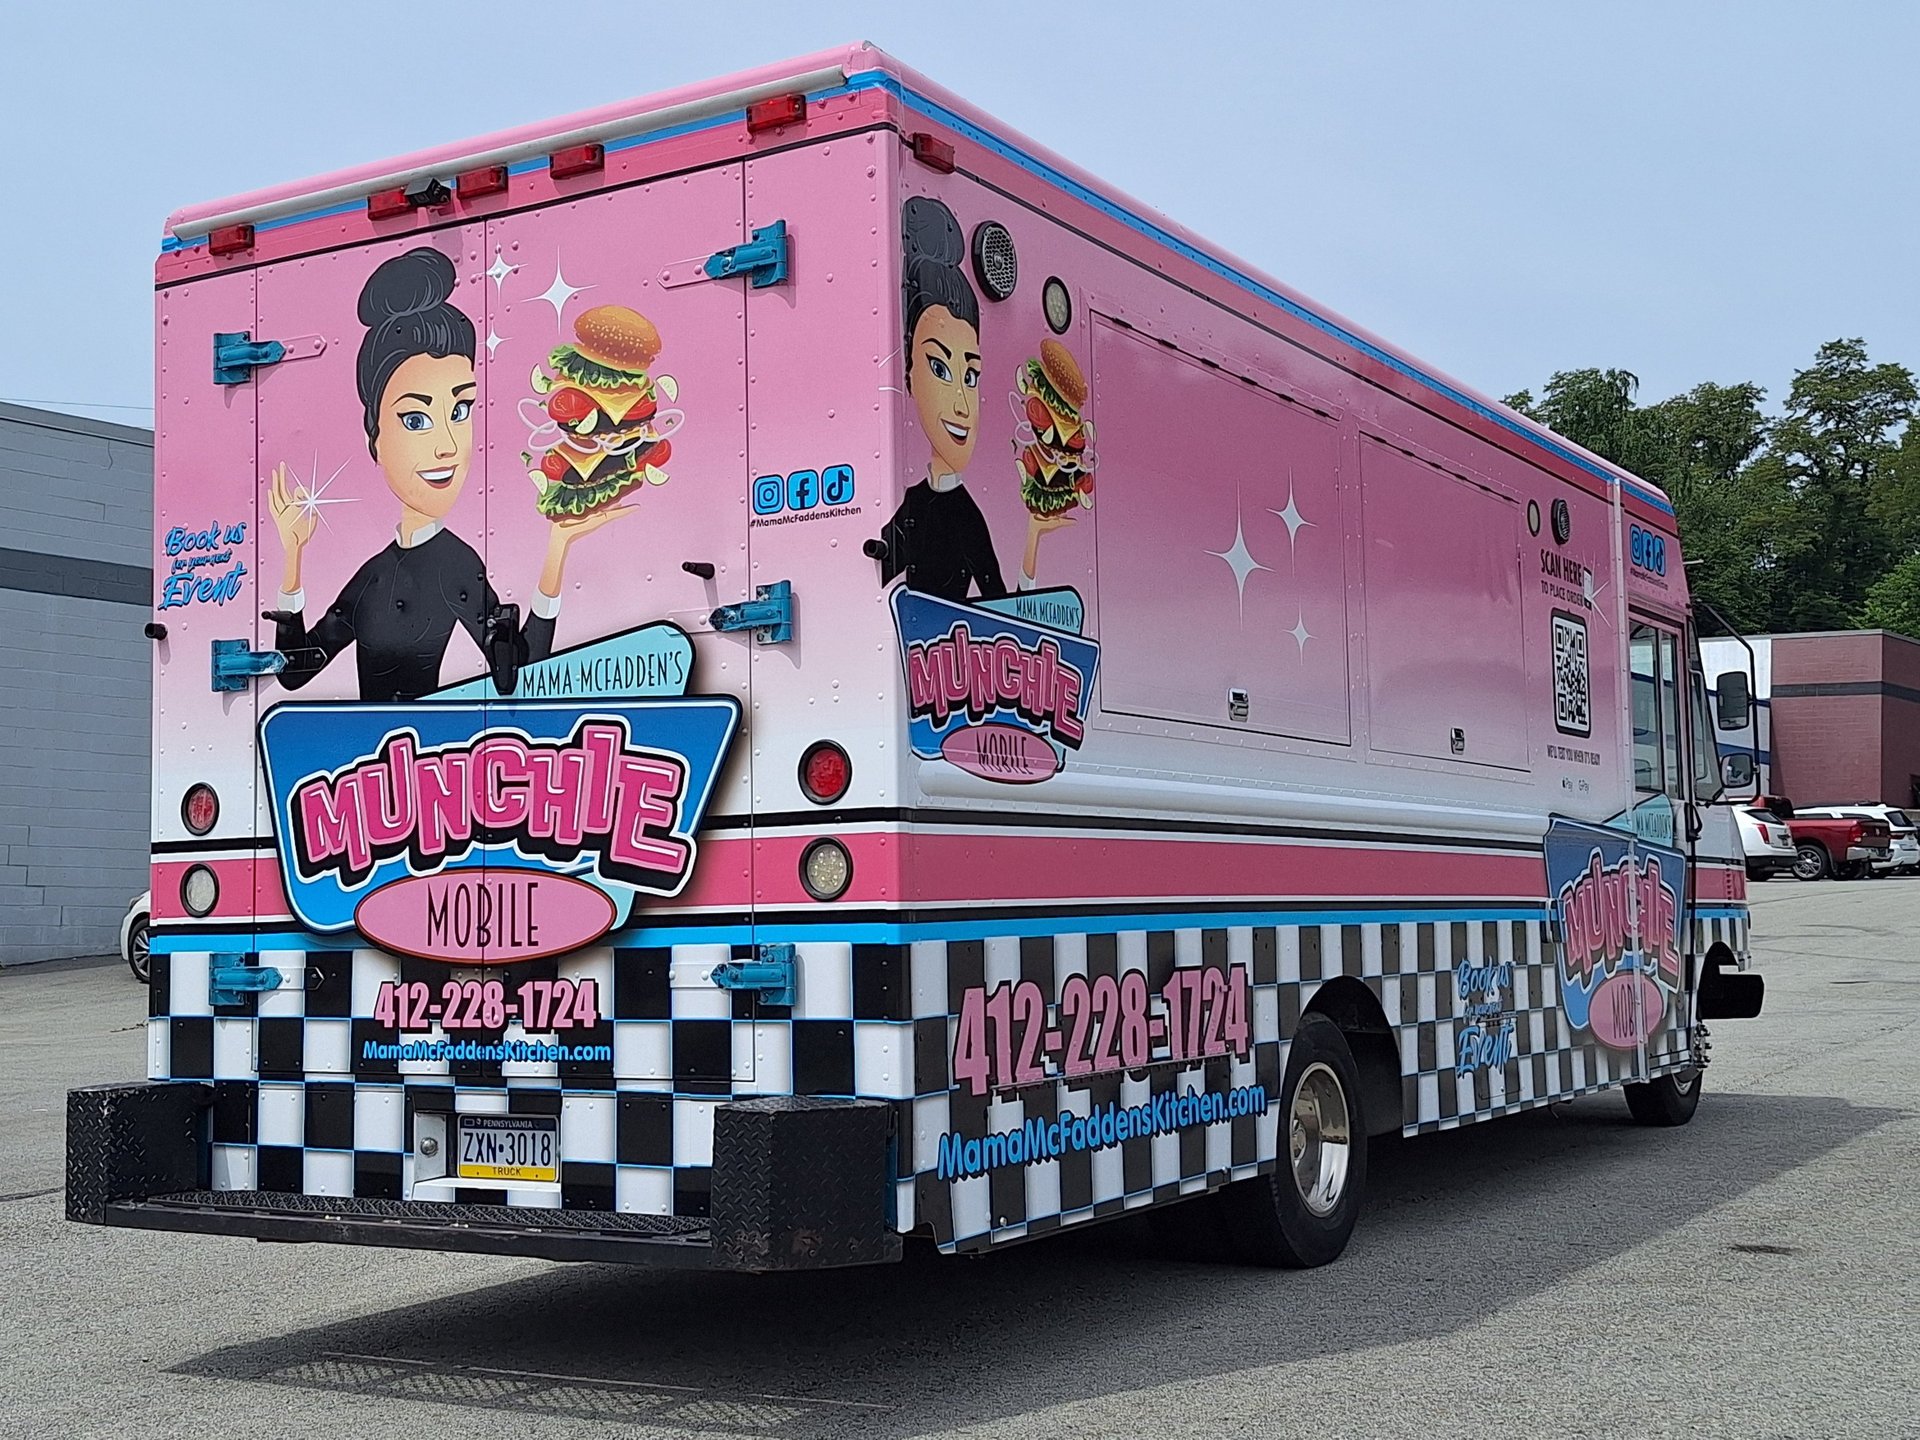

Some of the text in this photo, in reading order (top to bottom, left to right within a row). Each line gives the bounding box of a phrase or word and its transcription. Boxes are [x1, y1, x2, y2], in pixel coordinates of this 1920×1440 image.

[165, 520, 247, 556] Book us
[750, 507, 861, 528] #MamaMcFaddensKitchen
[158, 561, 248, 611] Event
[1541, 549, 1583, 587] SCAN HERE
[1541, 580, 1548, 594] TO
[1016, 599, 1079, 628] MAMA MCFADDEN'S
[523, 651, 683, 698] MAMA MCFADDEN'S
[909, 627, 1084, 741] MUNCHIE
[976, 730, 1034, 775] MOBILE
[299, 722, 691, 875] MUNCHIE
[427, 882, 541, 949] MOBILE
[1458, 956, 1514, 1000] Book us
[374, 979, 598, 1030] 412-228-1724
[1611, 983, 1648, 1039] MOB
[363, 1039, 611, 1062] MamaMcFaddensKitchen.com
[954, 966, 1250, 1096] 412-228-1724
[1457, 1020, 1514, 1079] Event
[483, 1117, 533, 1129] PENNSYLVANIA
[938, 1083, 1266, 1180] MamaMcFaddensKitchen.com
[492, 1167, 521, 1176] TRUCK
